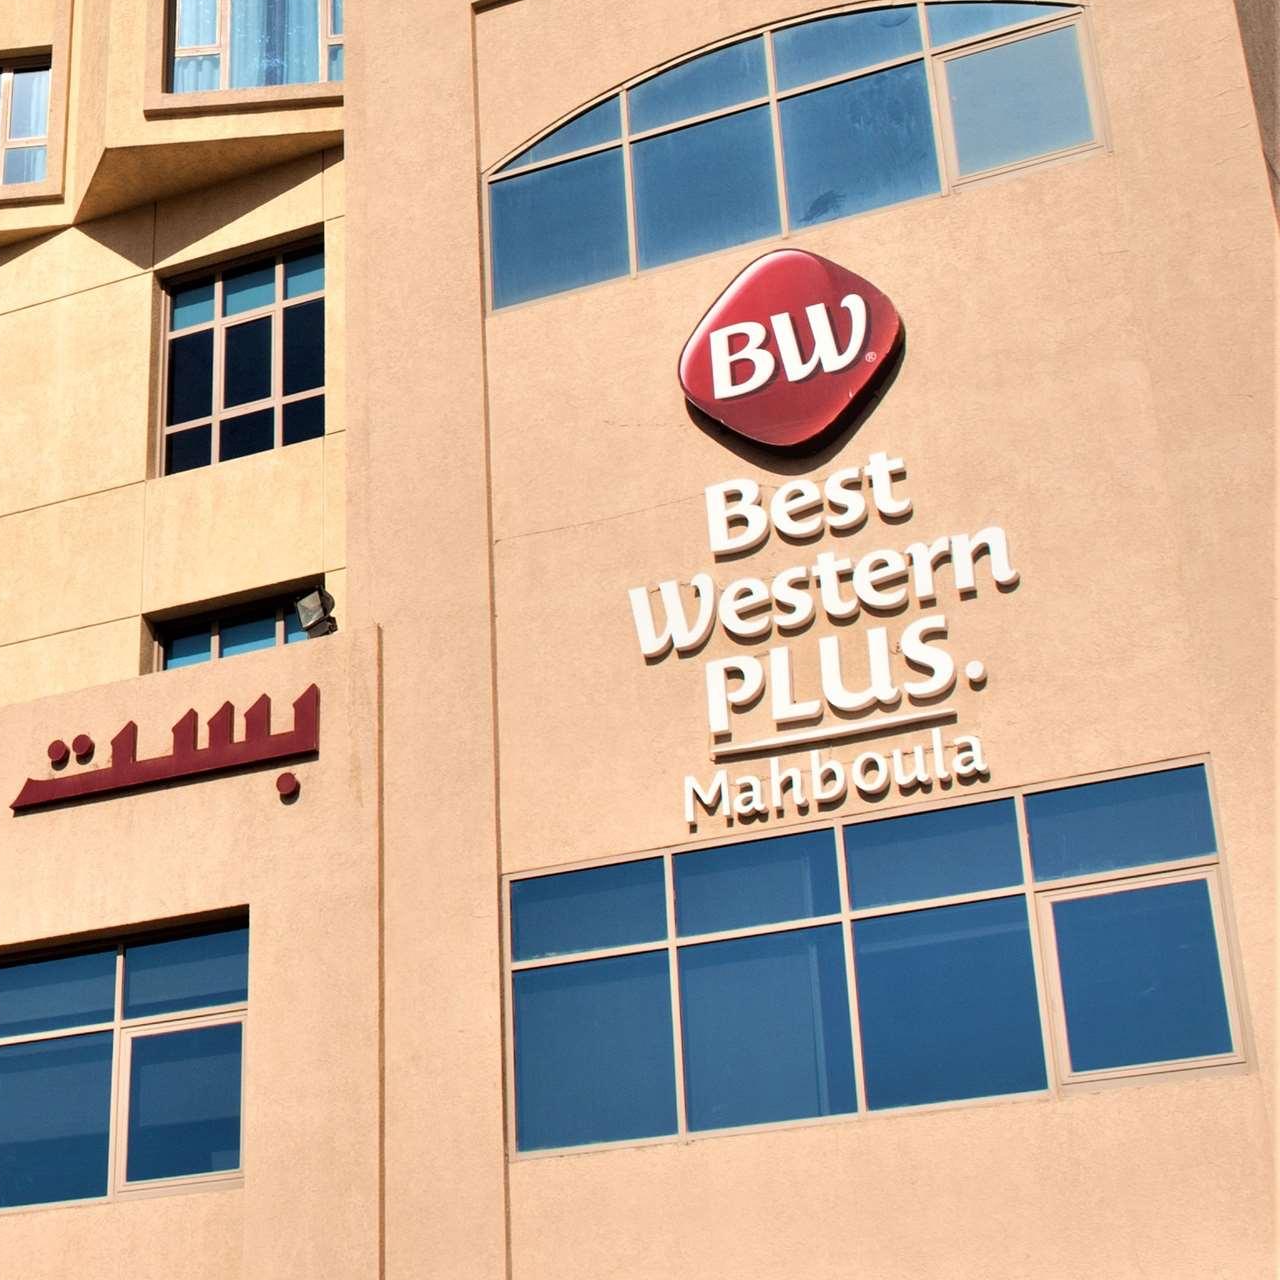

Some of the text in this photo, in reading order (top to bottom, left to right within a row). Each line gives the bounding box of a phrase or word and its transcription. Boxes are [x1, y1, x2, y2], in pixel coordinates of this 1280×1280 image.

[709, 293, 867, 400] BW
[703, 451, 915, 557] Best
[627, 521, 1020, 660] Western
[10, 683, 320, 813] بست
[683, 726, 990, 826] Mahboula
